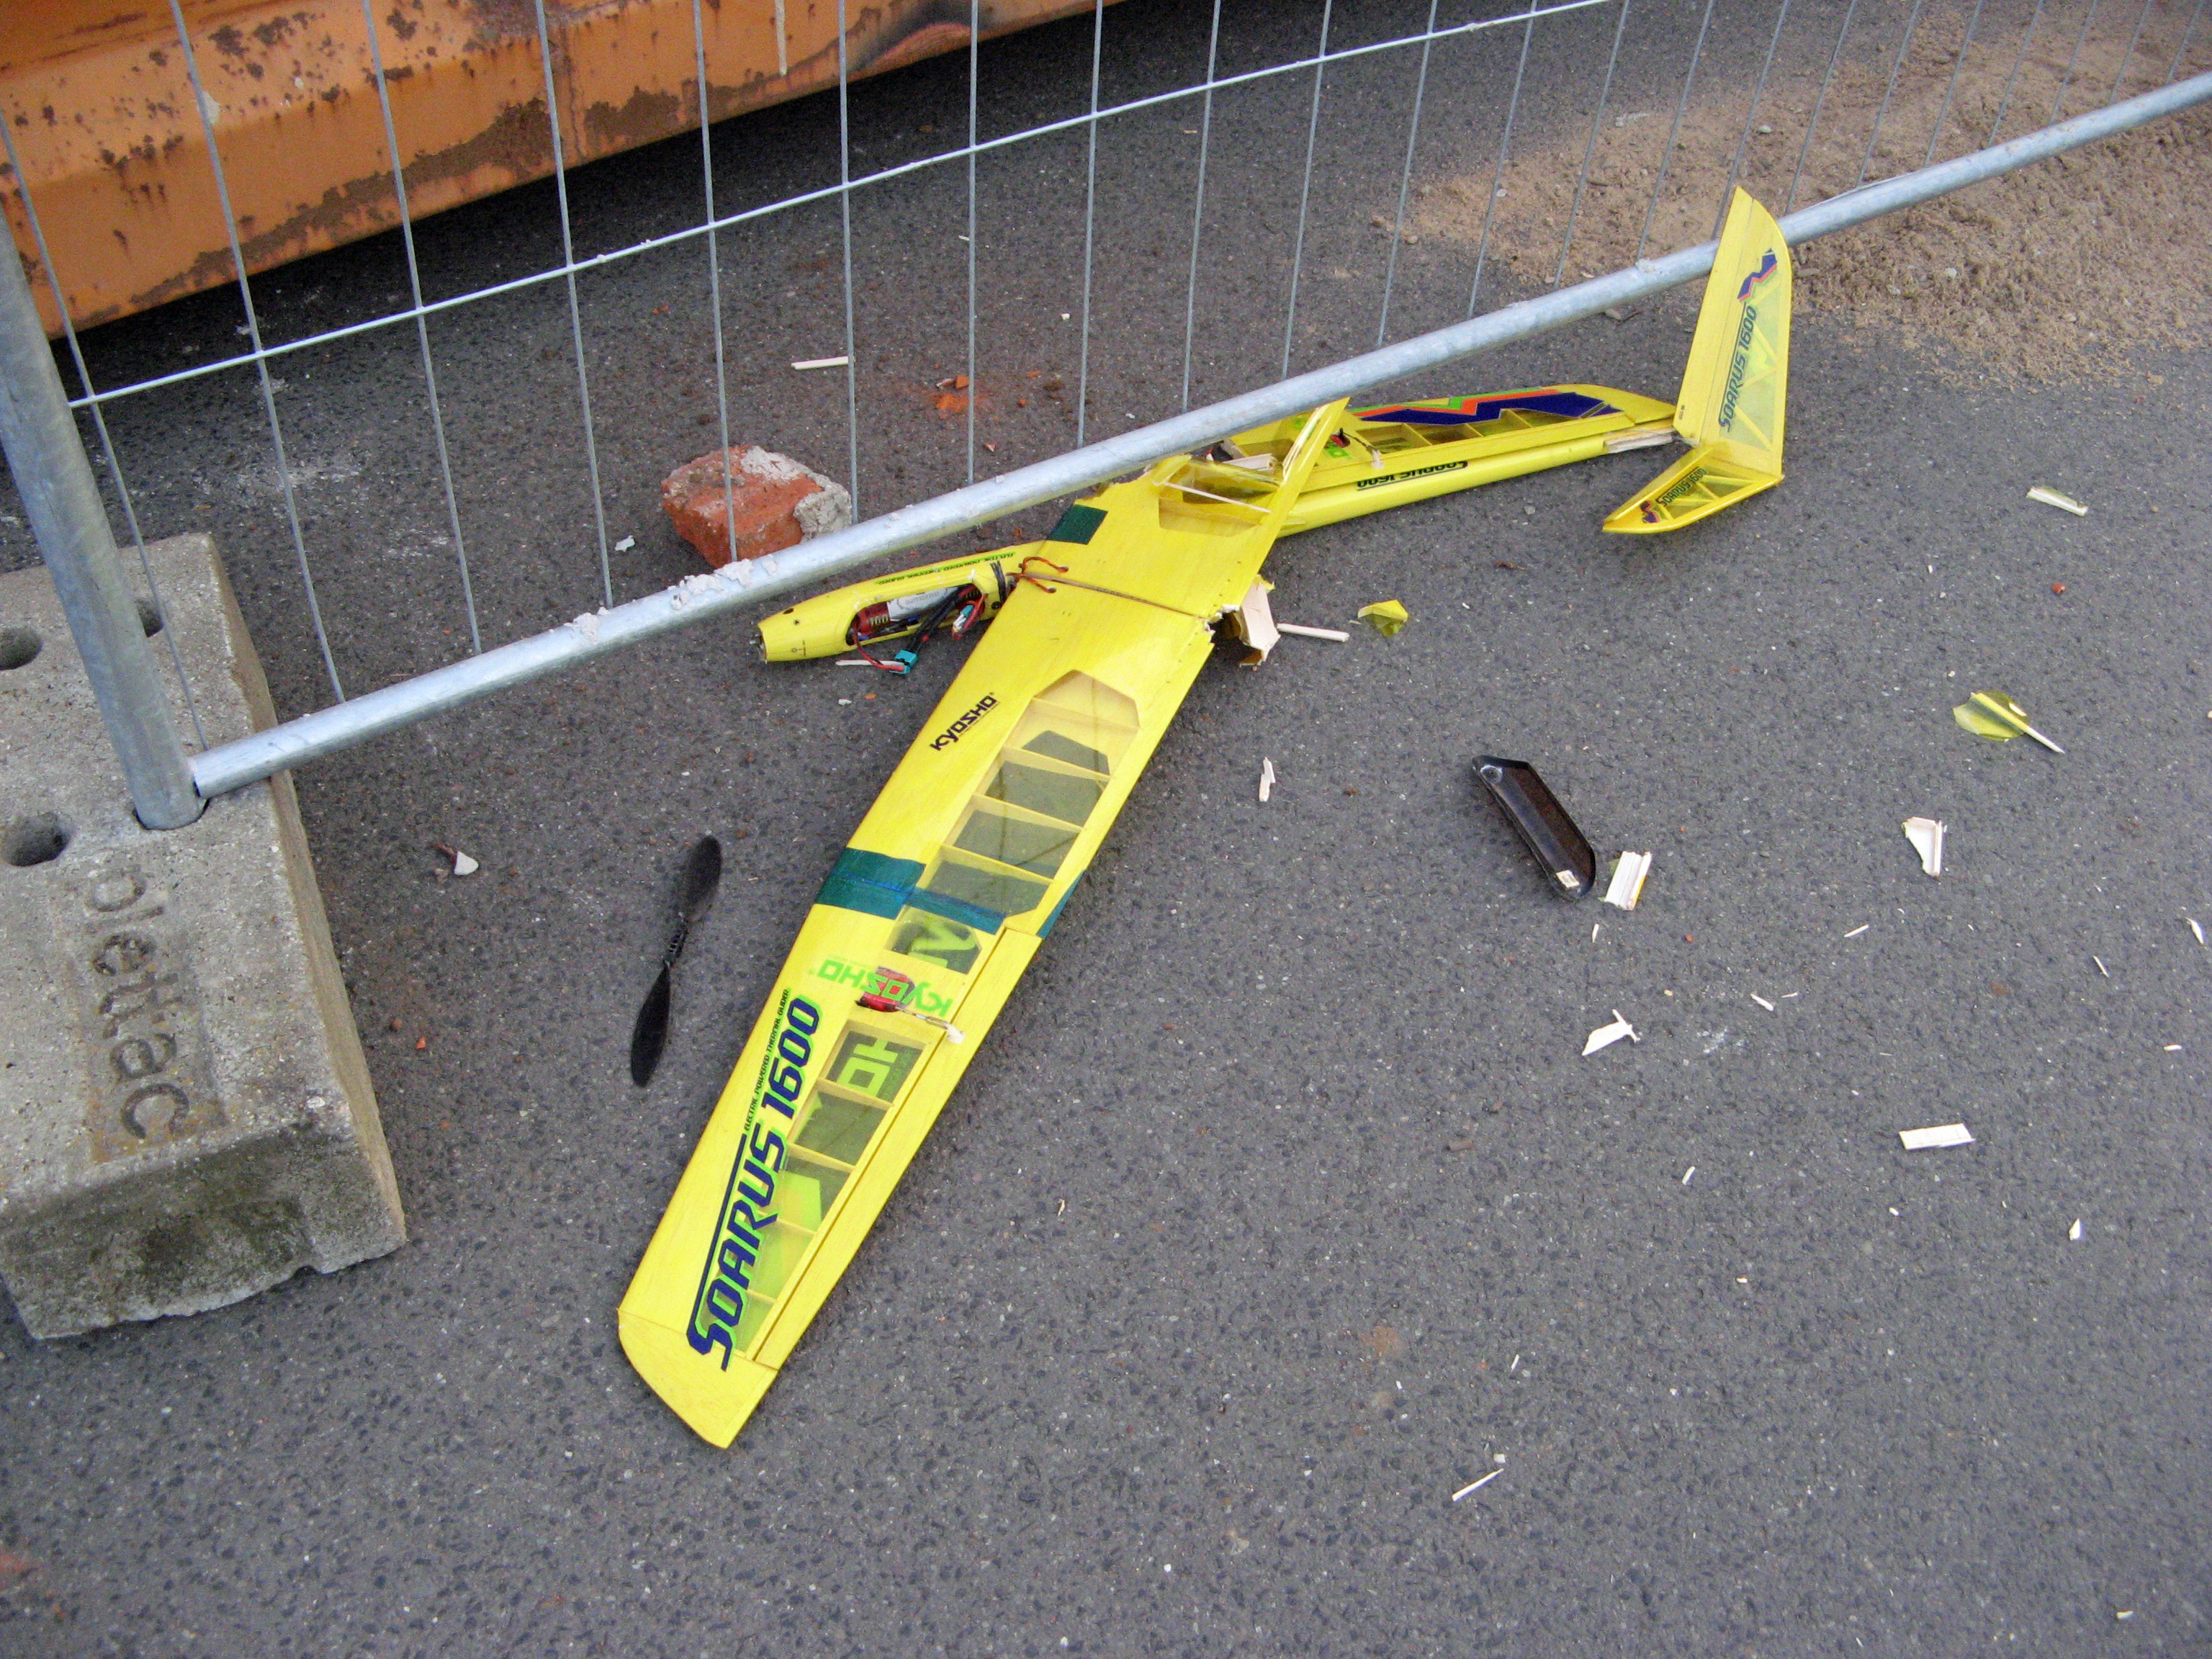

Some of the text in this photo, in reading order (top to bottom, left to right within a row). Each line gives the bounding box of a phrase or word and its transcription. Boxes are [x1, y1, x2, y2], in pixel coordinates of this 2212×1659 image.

[1717, 304, 1758, 433] SOARUS 1600
[1655, 467, 1707, 508] SOARUS 1600
[929, 695, 999, 751] KYOSHO
[817, 958, 953, 1017] KYOSHO
[743, 989, 789, 1132] ELECTRIC POWERED THERMAL GLIDER
[686, 997, 822, 1372] SOARUS 1600
